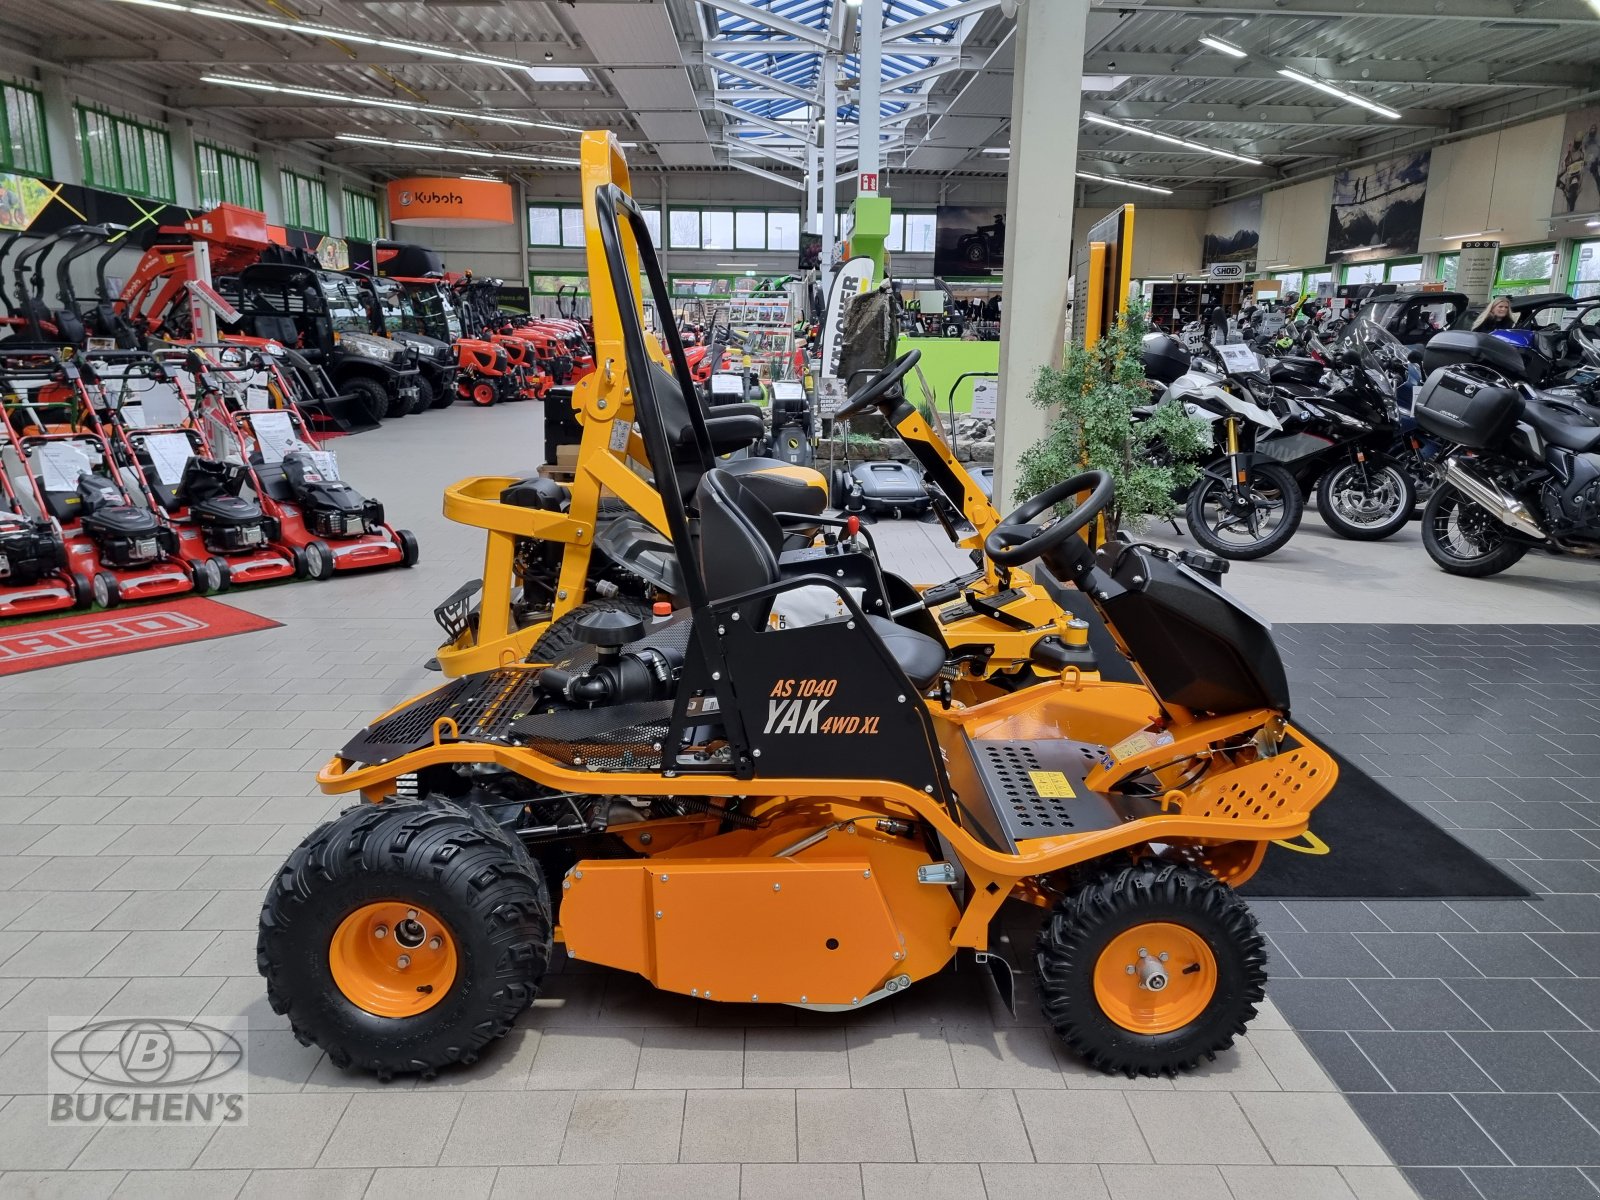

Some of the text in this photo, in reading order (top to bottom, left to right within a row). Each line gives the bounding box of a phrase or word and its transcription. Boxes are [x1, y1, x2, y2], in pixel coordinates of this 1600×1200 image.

[415, 191, 463, 204] Kubota
[1217, 267, 1238, 275] SHOEI
[0, 613, 190, 659] ABO
[770, 679, 839, 697] AS 1040
[763, 699, 881, 734] YAK 4WD XL
